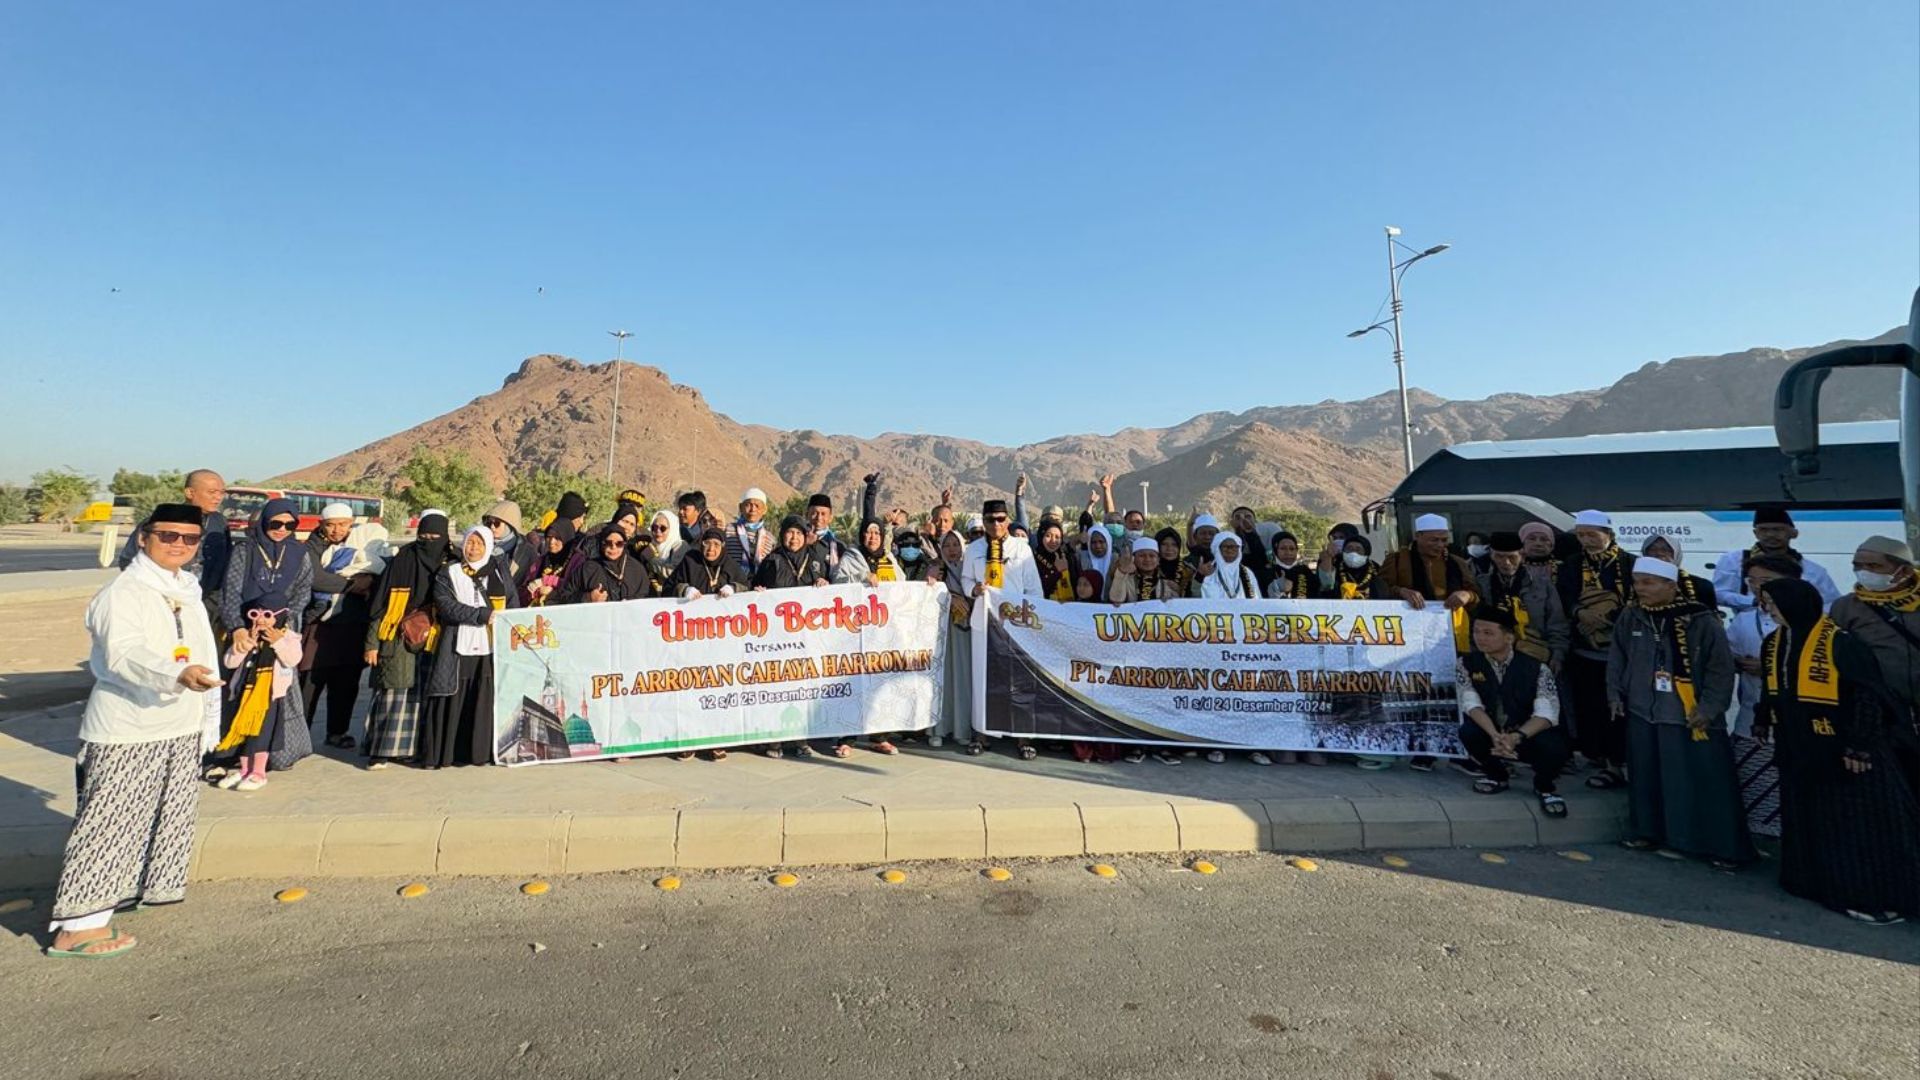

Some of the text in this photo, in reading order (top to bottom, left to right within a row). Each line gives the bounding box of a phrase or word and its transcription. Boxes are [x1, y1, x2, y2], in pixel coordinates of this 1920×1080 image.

[1618, 526, 1691, 536] 920006645
[652, 594, 889, 642] Umroh Berkah
[1093, 613, 1405, 645] UMROH BERKAH
[744, 641, 806, 653] Bersama
[1221, 650, 1282, 662] Bersama
[592, 673, 628, 699] PT.
[631, 663, 734, 695] ARROYAN
[736, 656, 819, 684] CAHAYA
[1070, 659, 1432, 694] PT. ARROYAN CAHAYA HARROMAIN
[699, 683, 852, 710] 12 s/d 25 Desember 2024
[1173, 696, 1327, 713] 11 s/d 24 Desember 2024
